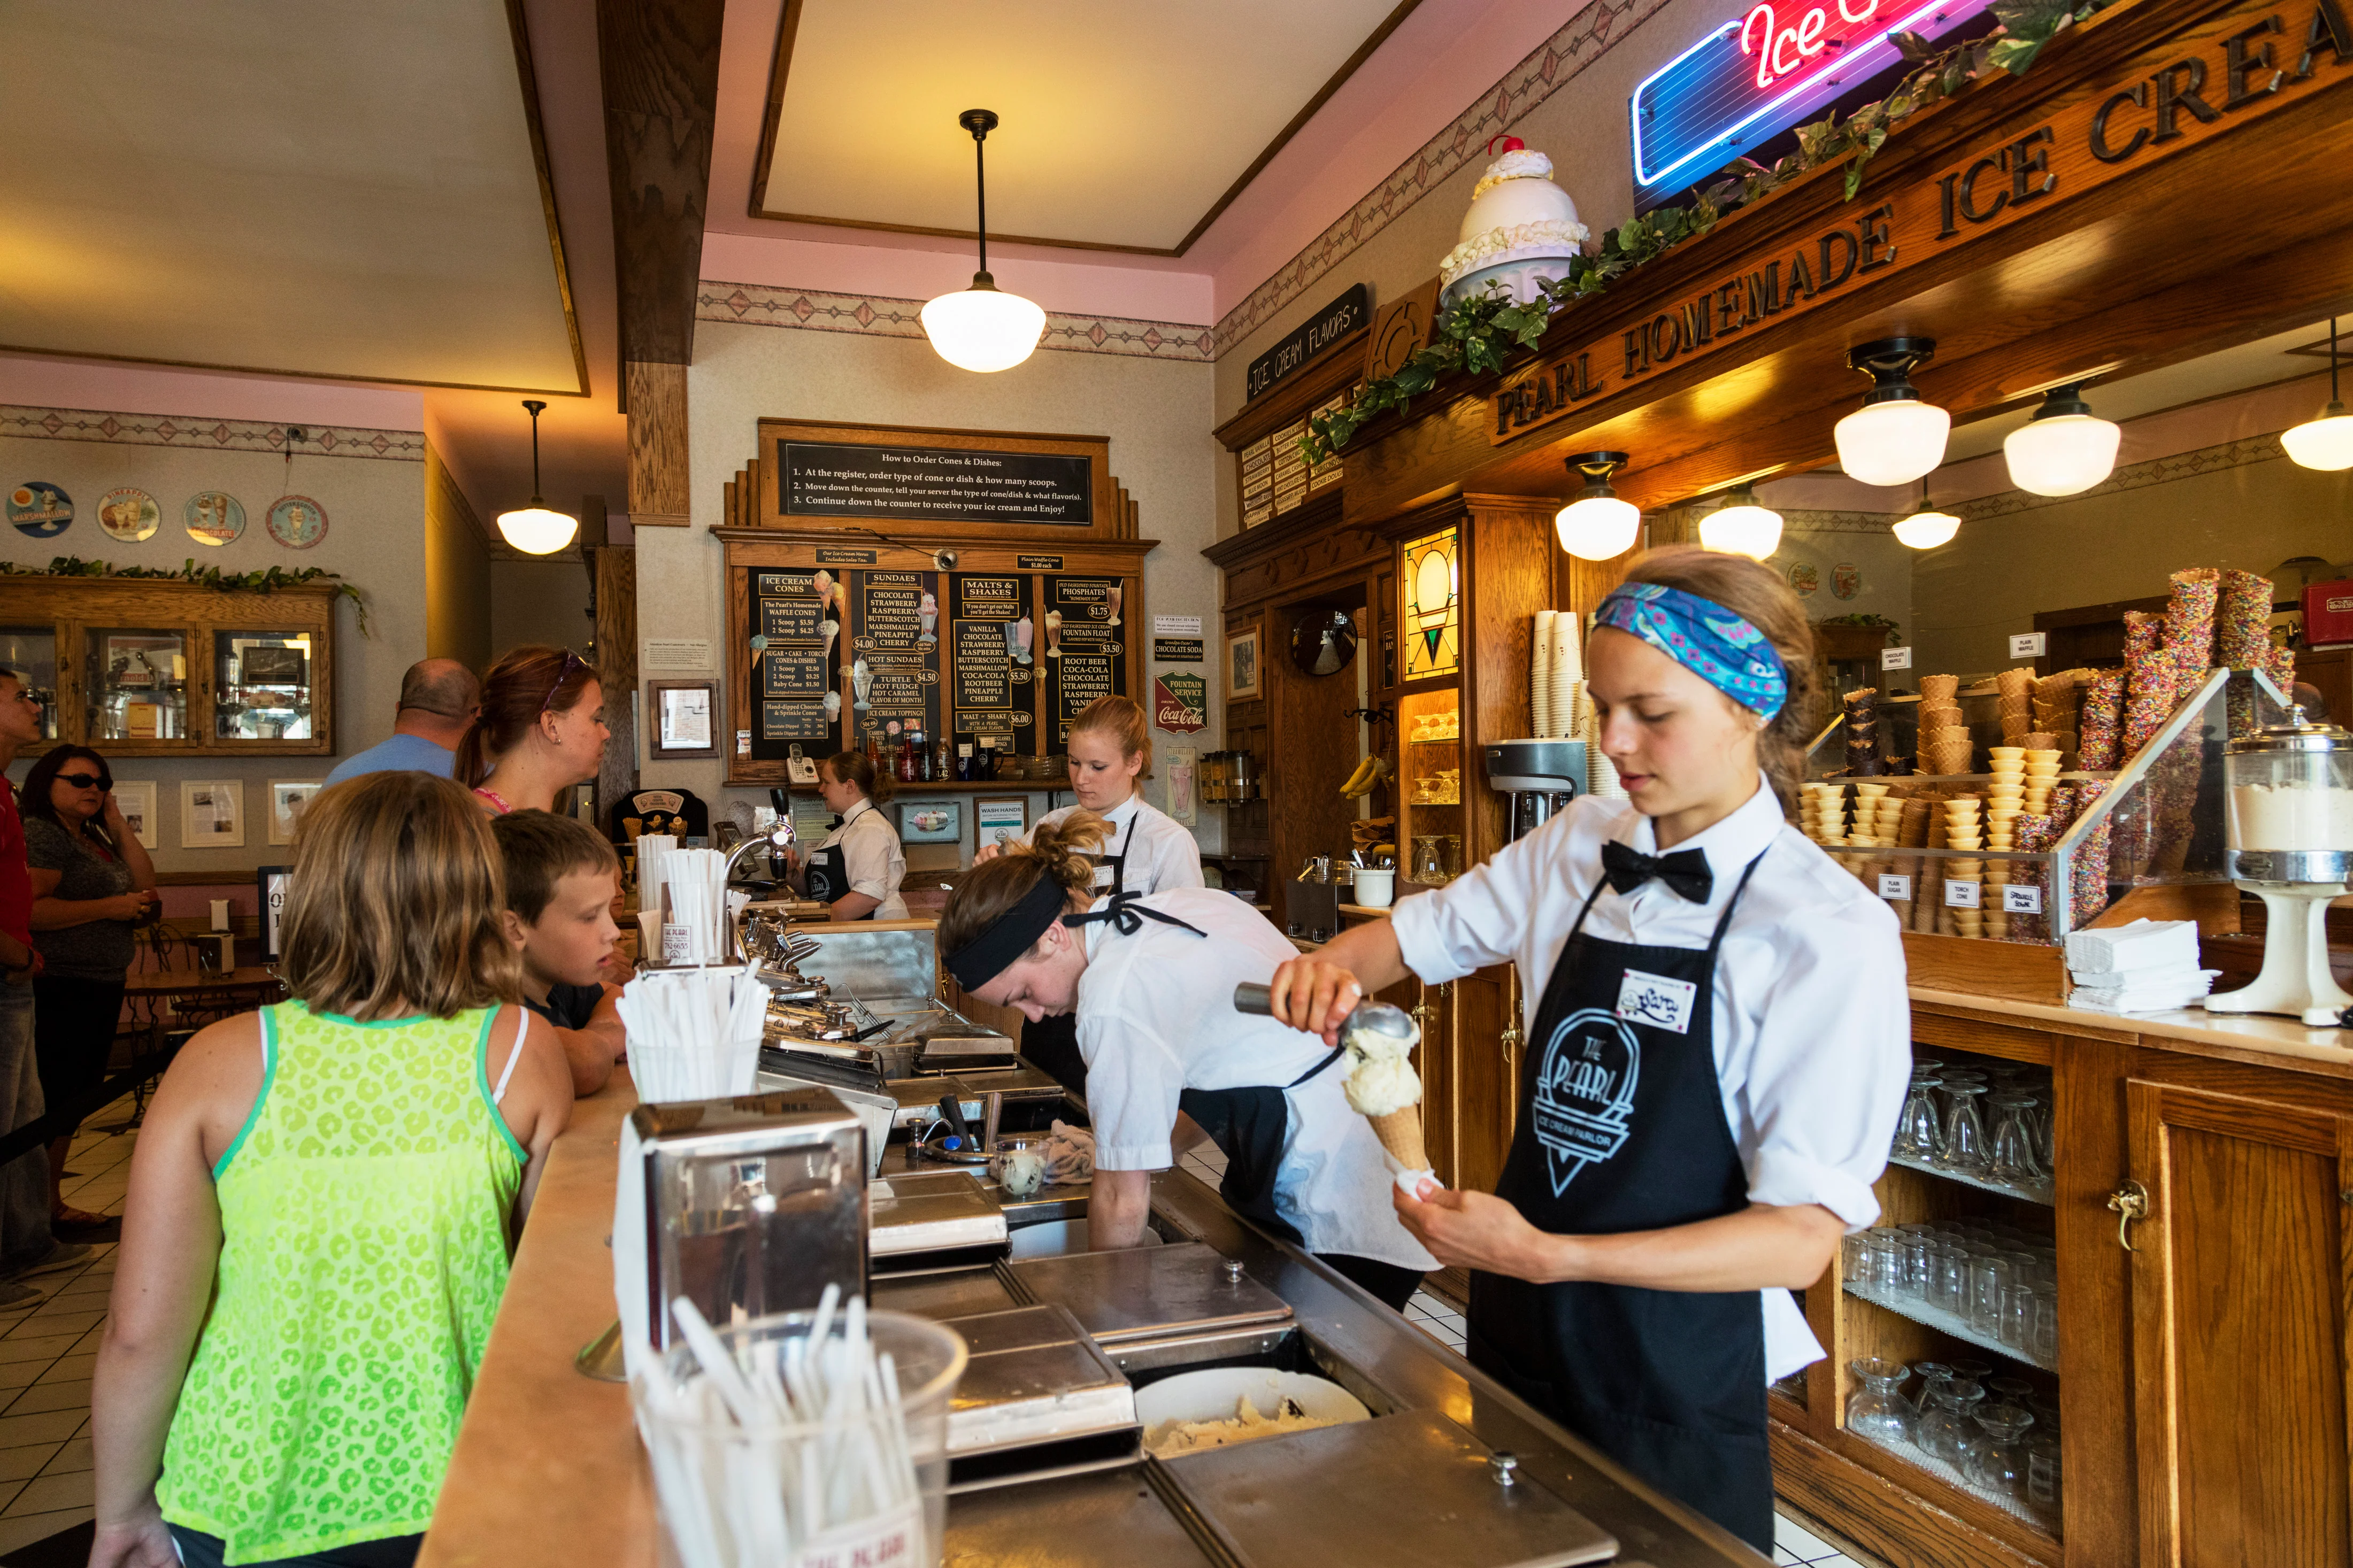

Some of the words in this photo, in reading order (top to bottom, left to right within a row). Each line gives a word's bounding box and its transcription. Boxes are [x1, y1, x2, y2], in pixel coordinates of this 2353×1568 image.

[1742, 4, 1826, 88] Ice
[1496, 352, 1603, 435] PEARL
[1621, 204, 1896, 379] HOMEMADE
[1935, 126, 2055, 242] ICE
[1254, 361, 1270, 395] ICE
[1275, 338, 1302, 377] CREAM
[1310, 305, 1350, 354] FLAVORS
[1275, 430, 1291, 441] COOKIES
[1244, 449, 1255, 459] PEARL
[1255, 439, 1270, 453] VANILLA
[1277, 442, 1289, 454] BUTTER
[882, 454, 901, 462] How
[939, 457, 962, 465] Cones
[973, 458, 1002, 466] Dishes:
[1246, 453, 1271, 472] CHOCOLATE
[1278, 454, 1293, 466] COTTON
[818, 469, 832, 477] the
[834, 470, 867, 480] register,
[894, 473, 912, 482] type
[1005, 478, 1027, 486] many
[1028, 480, 1057, 488] scoops.
[1245, 466, 1270, 484] STRAWBERRY
[1275, 468, 1291, 480] CARAMEL
[1248, 486, 1257, 495] BLUE
[1257, 480, 1268, 490] MOON
[1312, 477, 1327, 489] COOKIE
[107, 489, 151, 502] PINEAPPLE
[964, 490, 979, 498] type
[990, 490, 1023, 498] cone/dish
[1051, 492, 1082, 501] flavor(s).
[1294, 487, 1305, 496] MUDD
[806, 496, 846, 505] Continue
[848, 497, 872, 506] down
[874, 498, 887, 507] the
[889, 500, 921, 508] counter
[923, 500, 931, 508] to
[1023, 504, 1037, 512] and
[1040, 505, 1065, 514] Enjoy!
[12, 509, 71, 522] MARSHMALLOW
[1090, 607, 1108, 615] $1.75
[778, 627, 795, 635] Scoop
[855, 639, 873, 648] $4.00
[1102, 645, 1119, 653] $3.50
[917, 673, 936, 682] $4.50
[1010, 672, 1028, 681] $5.50
[1011, 715, 1028, 723] $6.00
[1159, 706, 1204, 724] Coca-Cola
[1582, 1035, 1606, 1061] THE
[1552, 1054, 1617, 1106] PEARL
